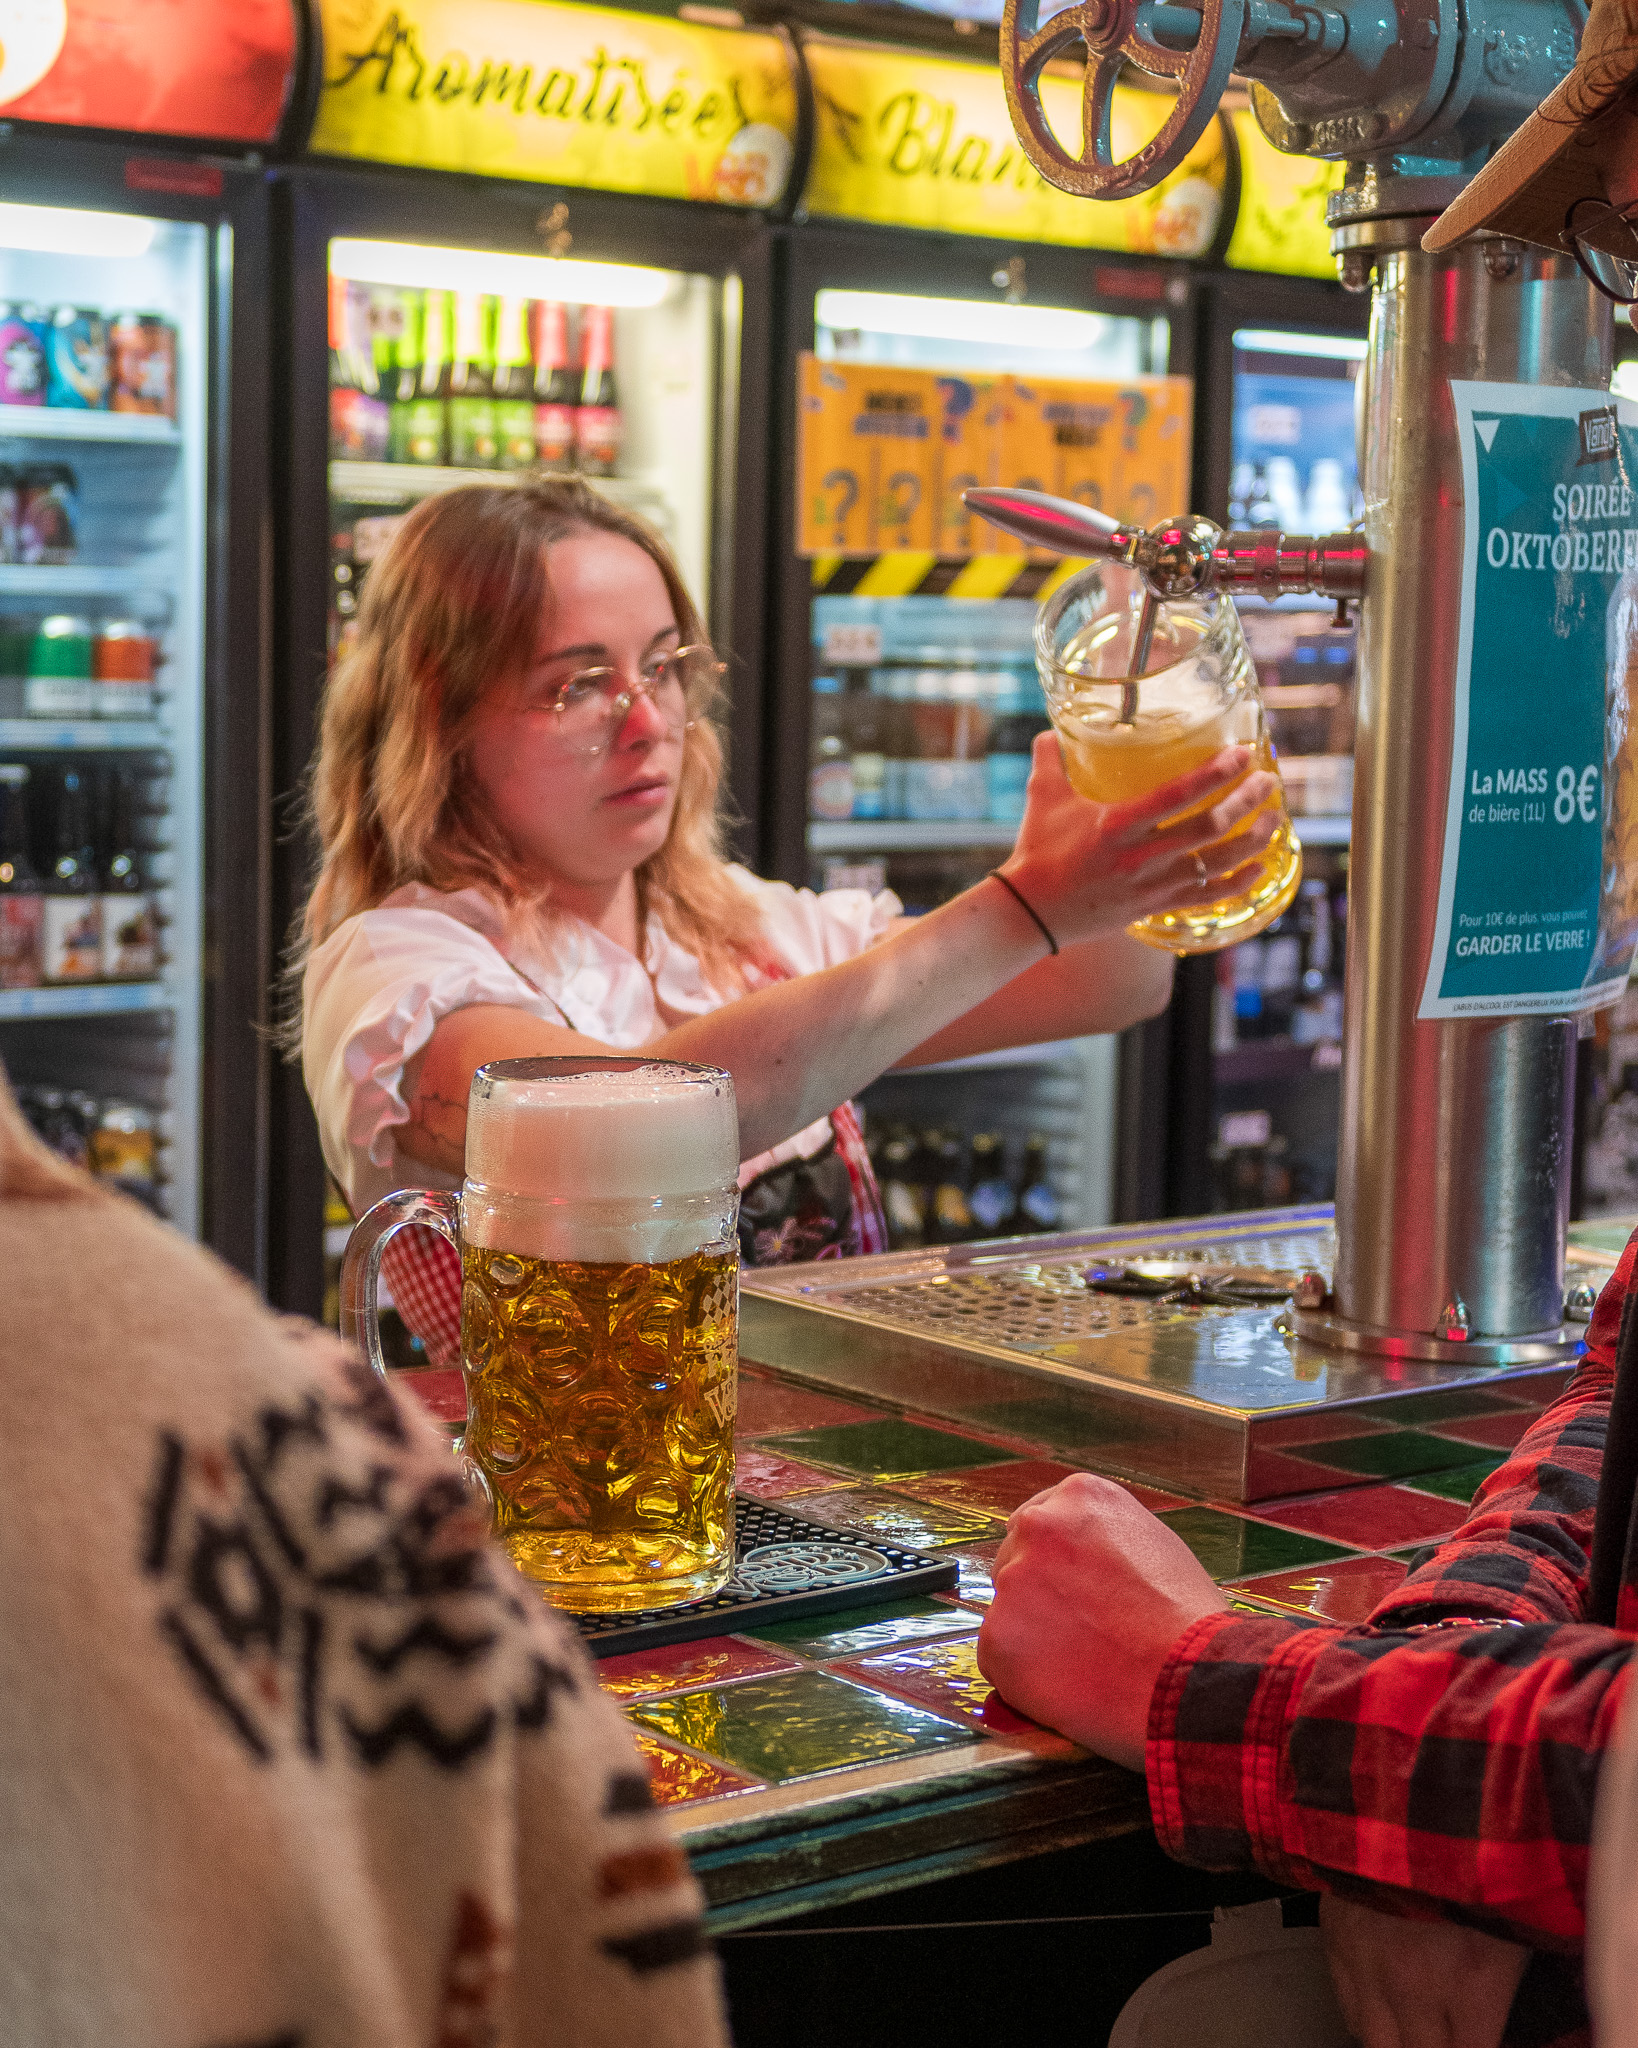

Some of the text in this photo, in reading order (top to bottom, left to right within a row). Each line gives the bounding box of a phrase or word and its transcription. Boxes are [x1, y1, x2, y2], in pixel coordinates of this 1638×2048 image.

[326, 11, 755, 140] Aromatisées
[877, 91, 1050, 193] Blan
[1552, 477, 1632, 522] SOIRÉE
[1471, 767, 1549, 795] La MASS
[1553, 764, 1599, 824] 8€
[1468, 801, 1546, 824] de bière (1L)
[1459, 913, 1482, 927] Pour
[1486, 912, 1504, 926] 10€
[1505, 911, 1517, 925] de
[1541, 912, 1561, 922] vous
[1456, 934, 1522, 957] GARDER
[1525, 933, 1542, 953] LE
